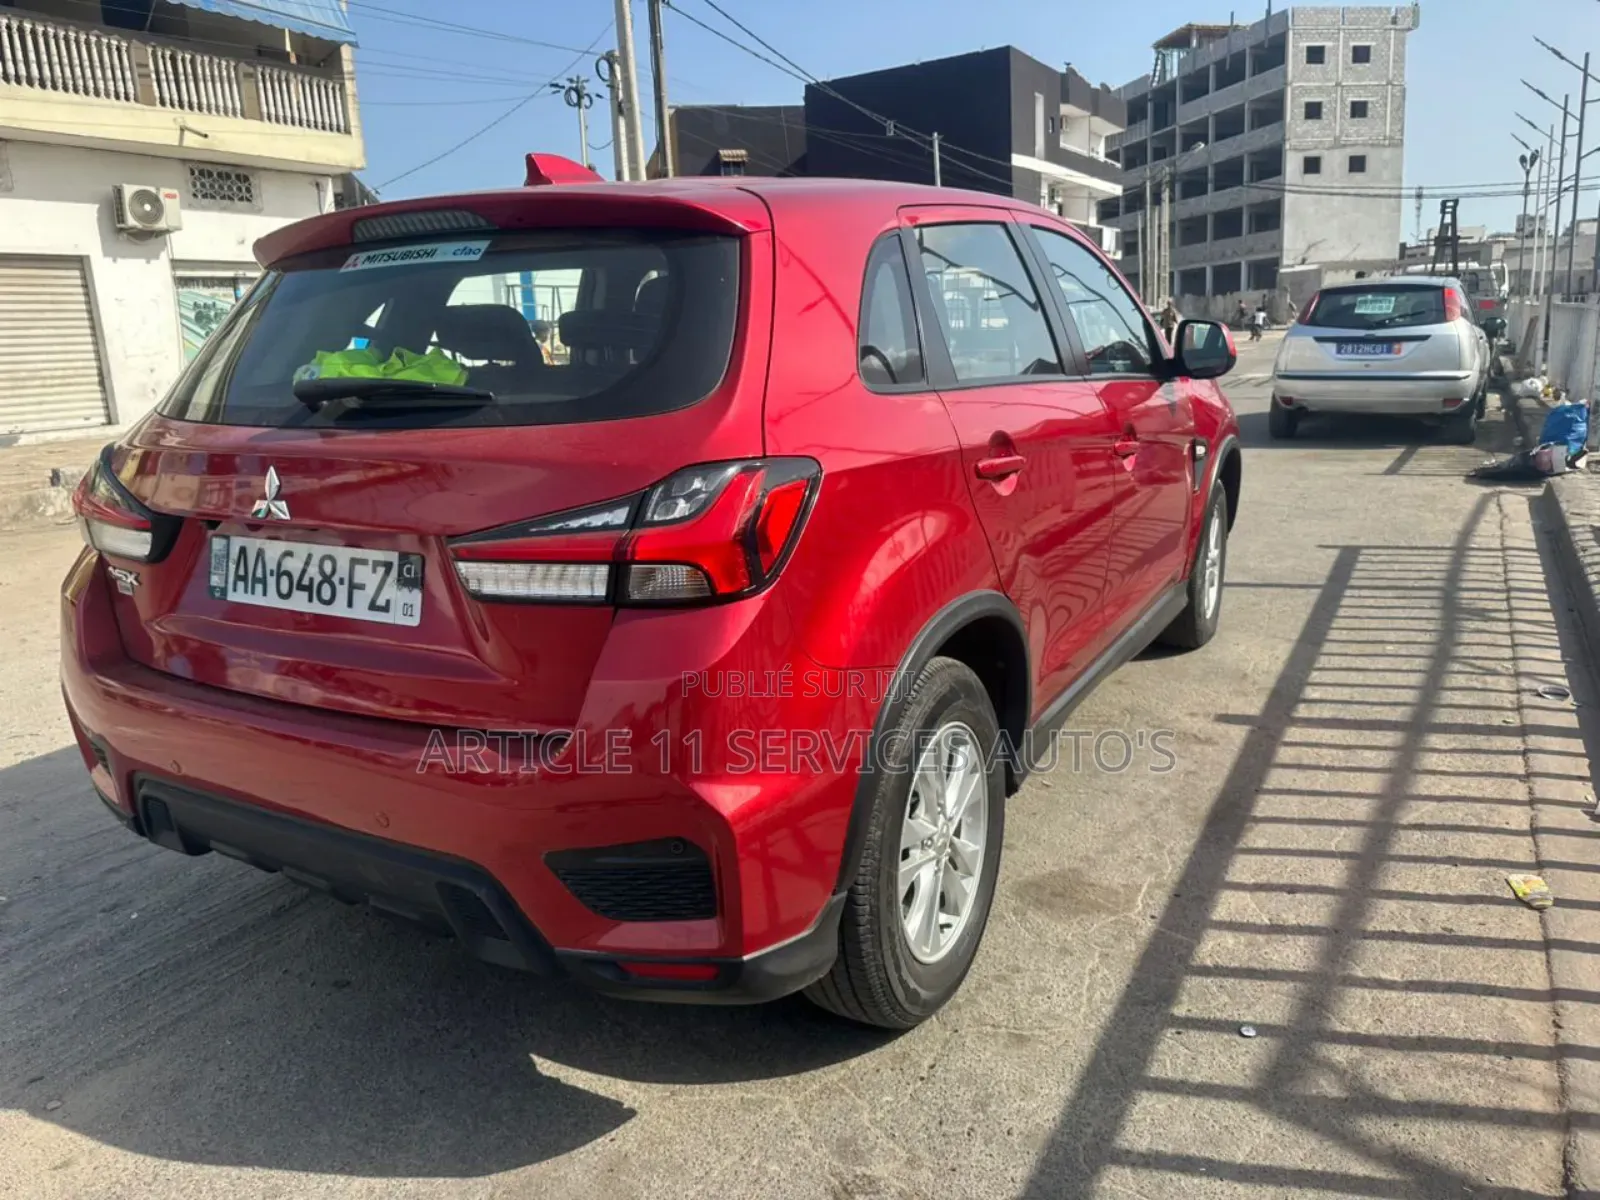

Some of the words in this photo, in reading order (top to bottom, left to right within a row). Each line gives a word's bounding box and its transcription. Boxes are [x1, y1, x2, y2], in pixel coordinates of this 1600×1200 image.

[362, 248, 439, 265] MITSUBISHI
[403, 564, 415, 578] CI
[402, 602, 414, 617] 01
